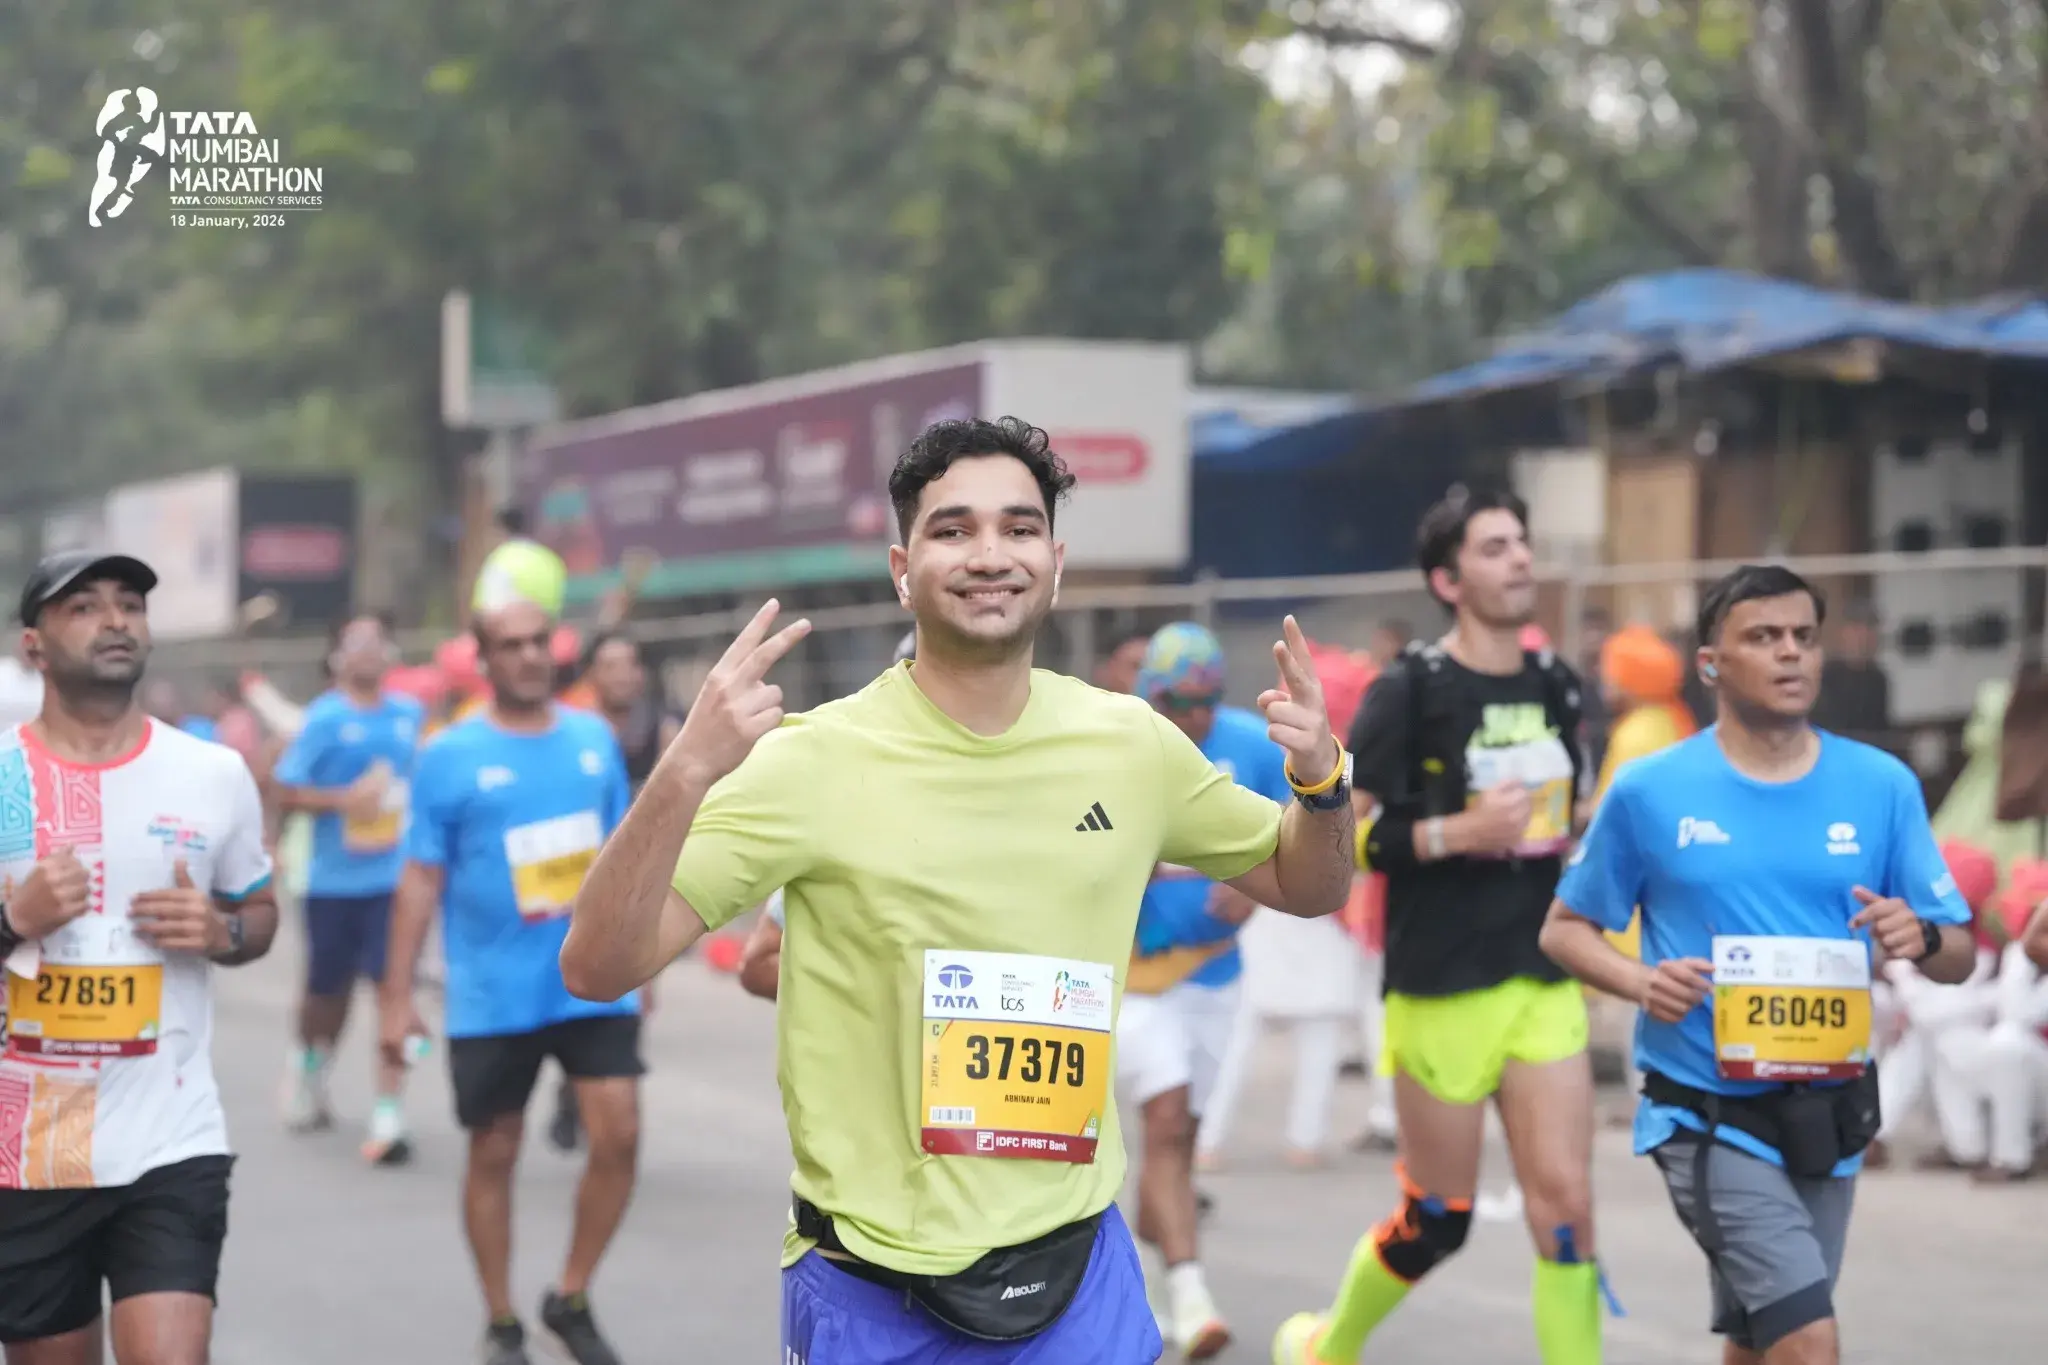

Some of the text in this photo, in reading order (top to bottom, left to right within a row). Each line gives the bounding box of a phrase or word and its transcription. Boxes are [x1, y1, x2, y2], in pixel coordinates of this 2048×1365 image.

[37, 973, 136, 1007] 27851
[1071, 979, 1090, 989] TATA
[1071, 987, 1095, 997] MUMBAI
[932, 994, 979, 1010] TATA
[1001, 994, 1024, 1012] tcs
[1071, 997, 1104, 1008] MARATHON
[1747, 994, 1847, 1029] 26049
[932, 1023, 940, 1036] C
[966, 1035, 1085, 1087] 37379
[1004, 1093, 1051, 1106] ABHINAV JAIN
[995, 1135, 1068, 1152] IDFC FIRST Bank
